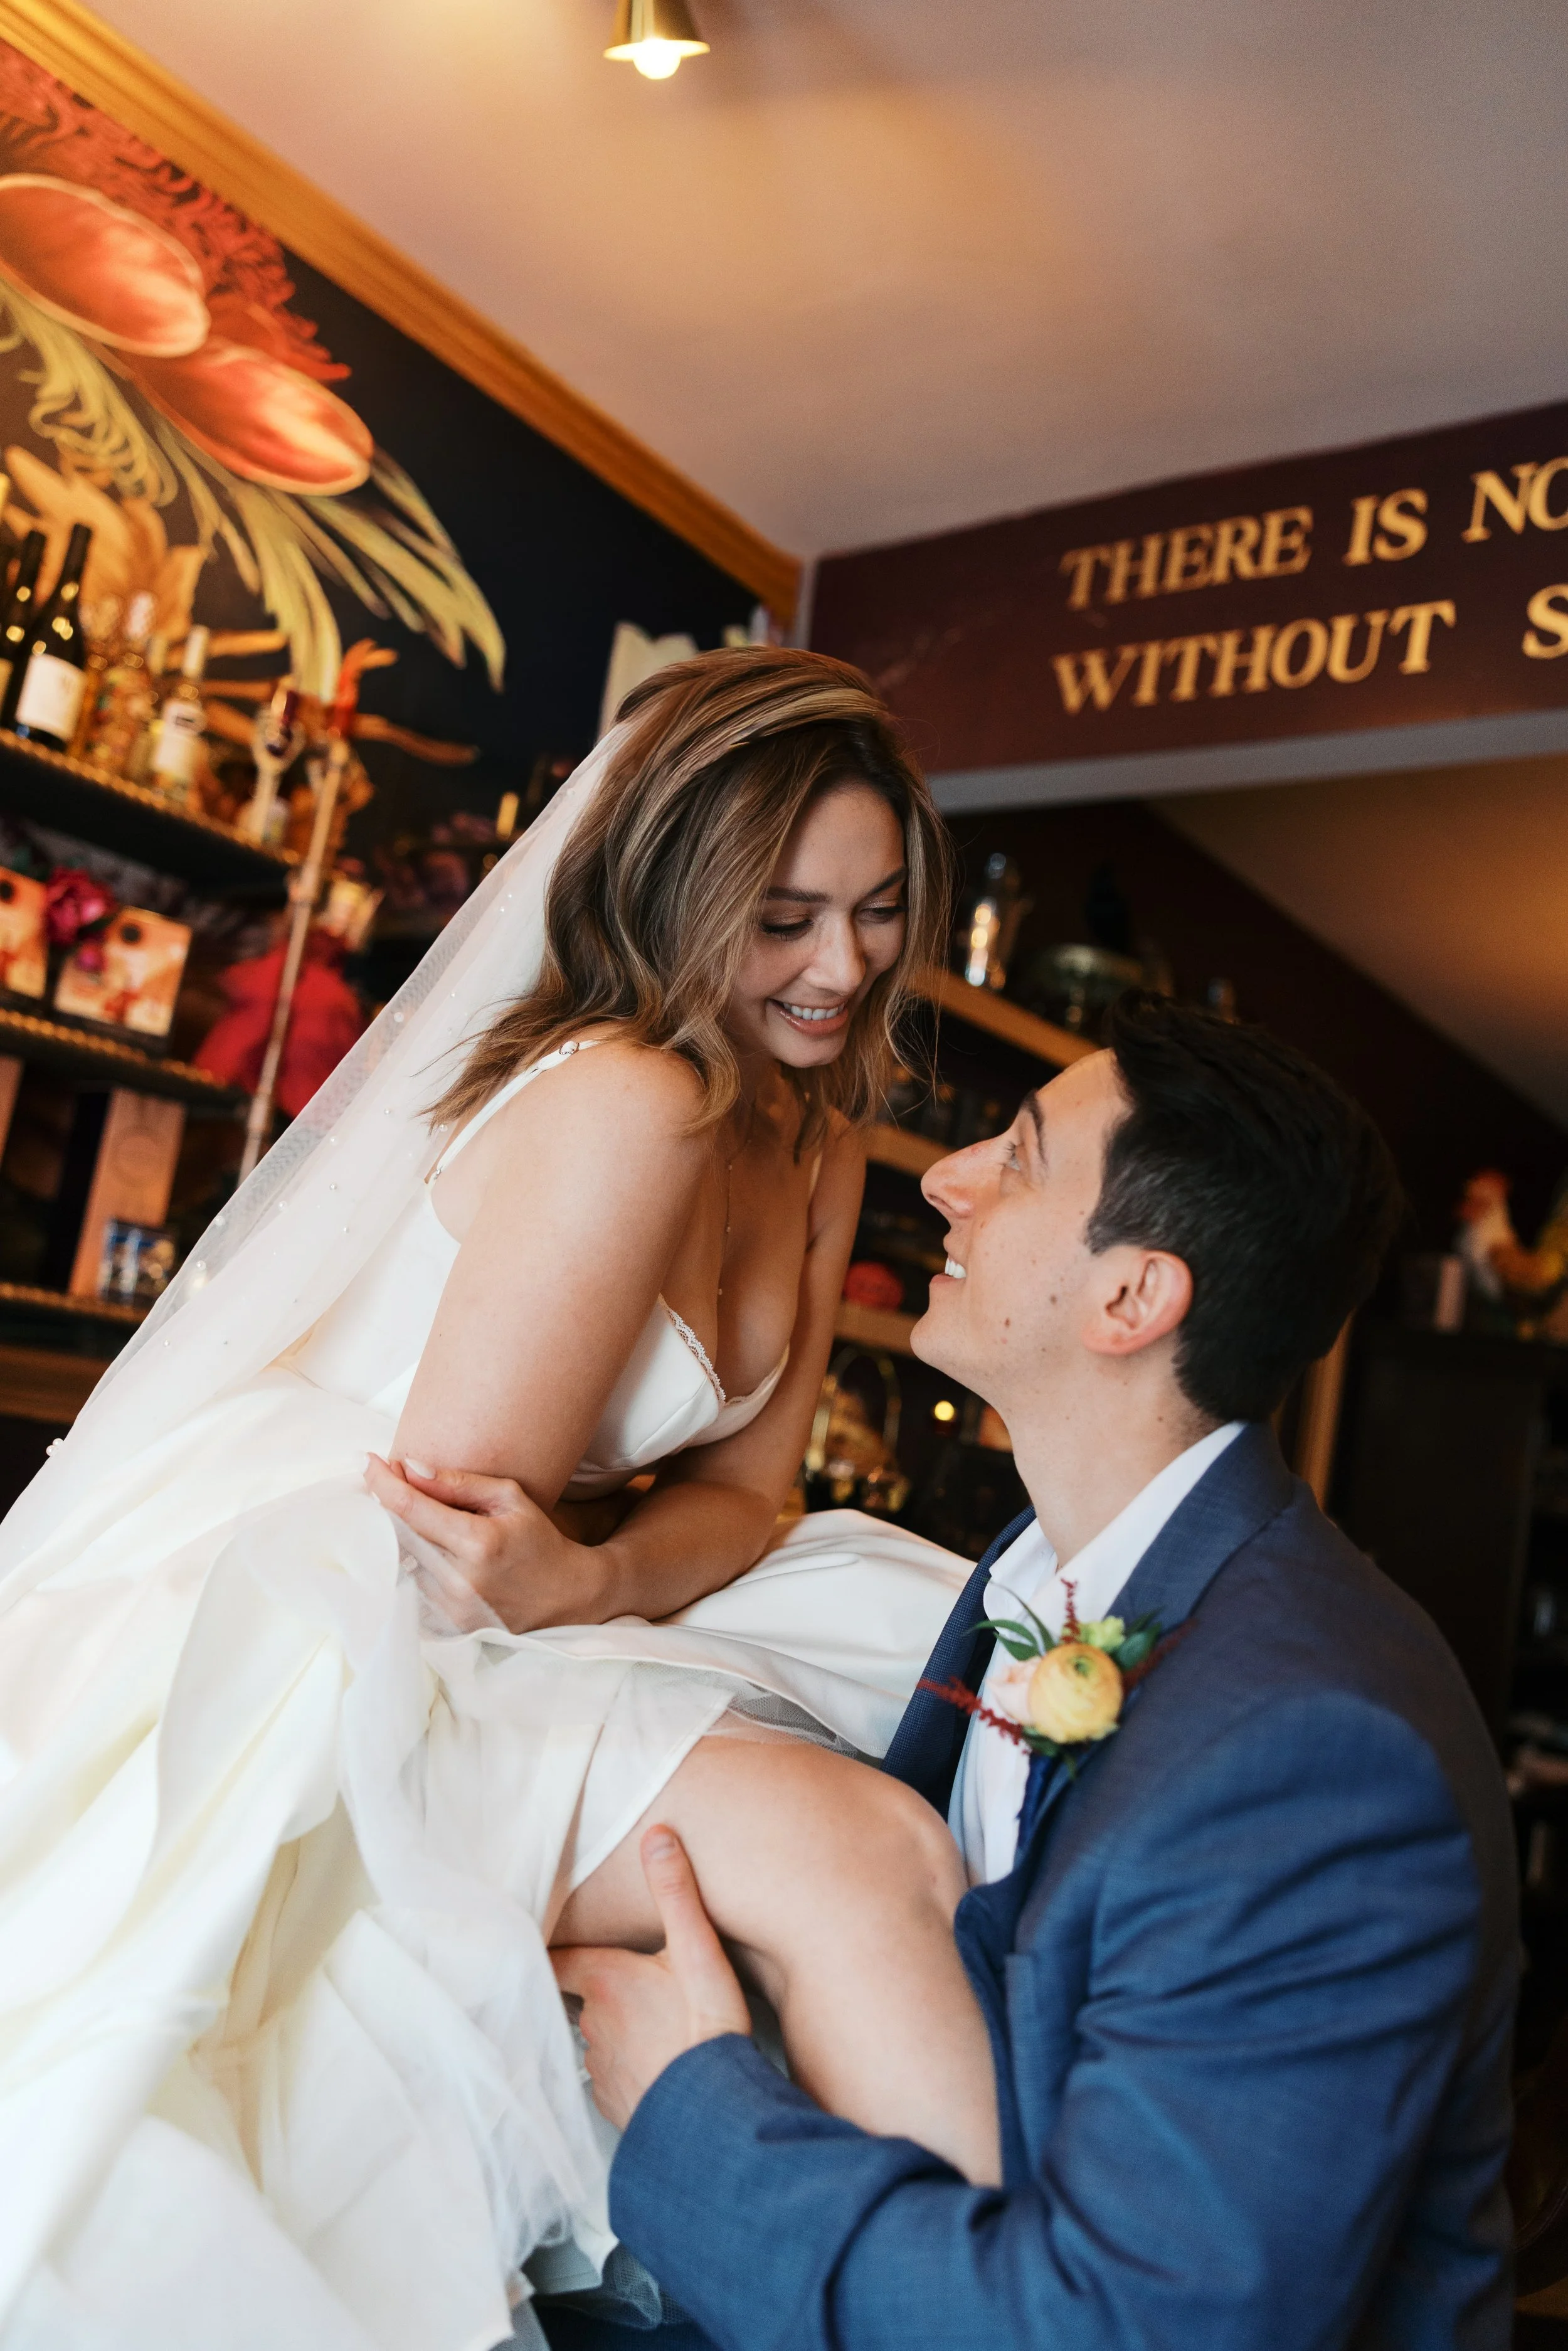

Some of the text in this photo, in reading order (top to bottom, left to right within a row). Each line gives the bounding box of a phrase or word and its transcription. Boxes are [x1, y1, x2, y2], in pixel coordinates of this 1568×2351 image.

[1059, 506, 1313, 611] THERE
[1345, 489, 1428, 566] IS
[1050, 600, 1456, 714] WITHOUT
